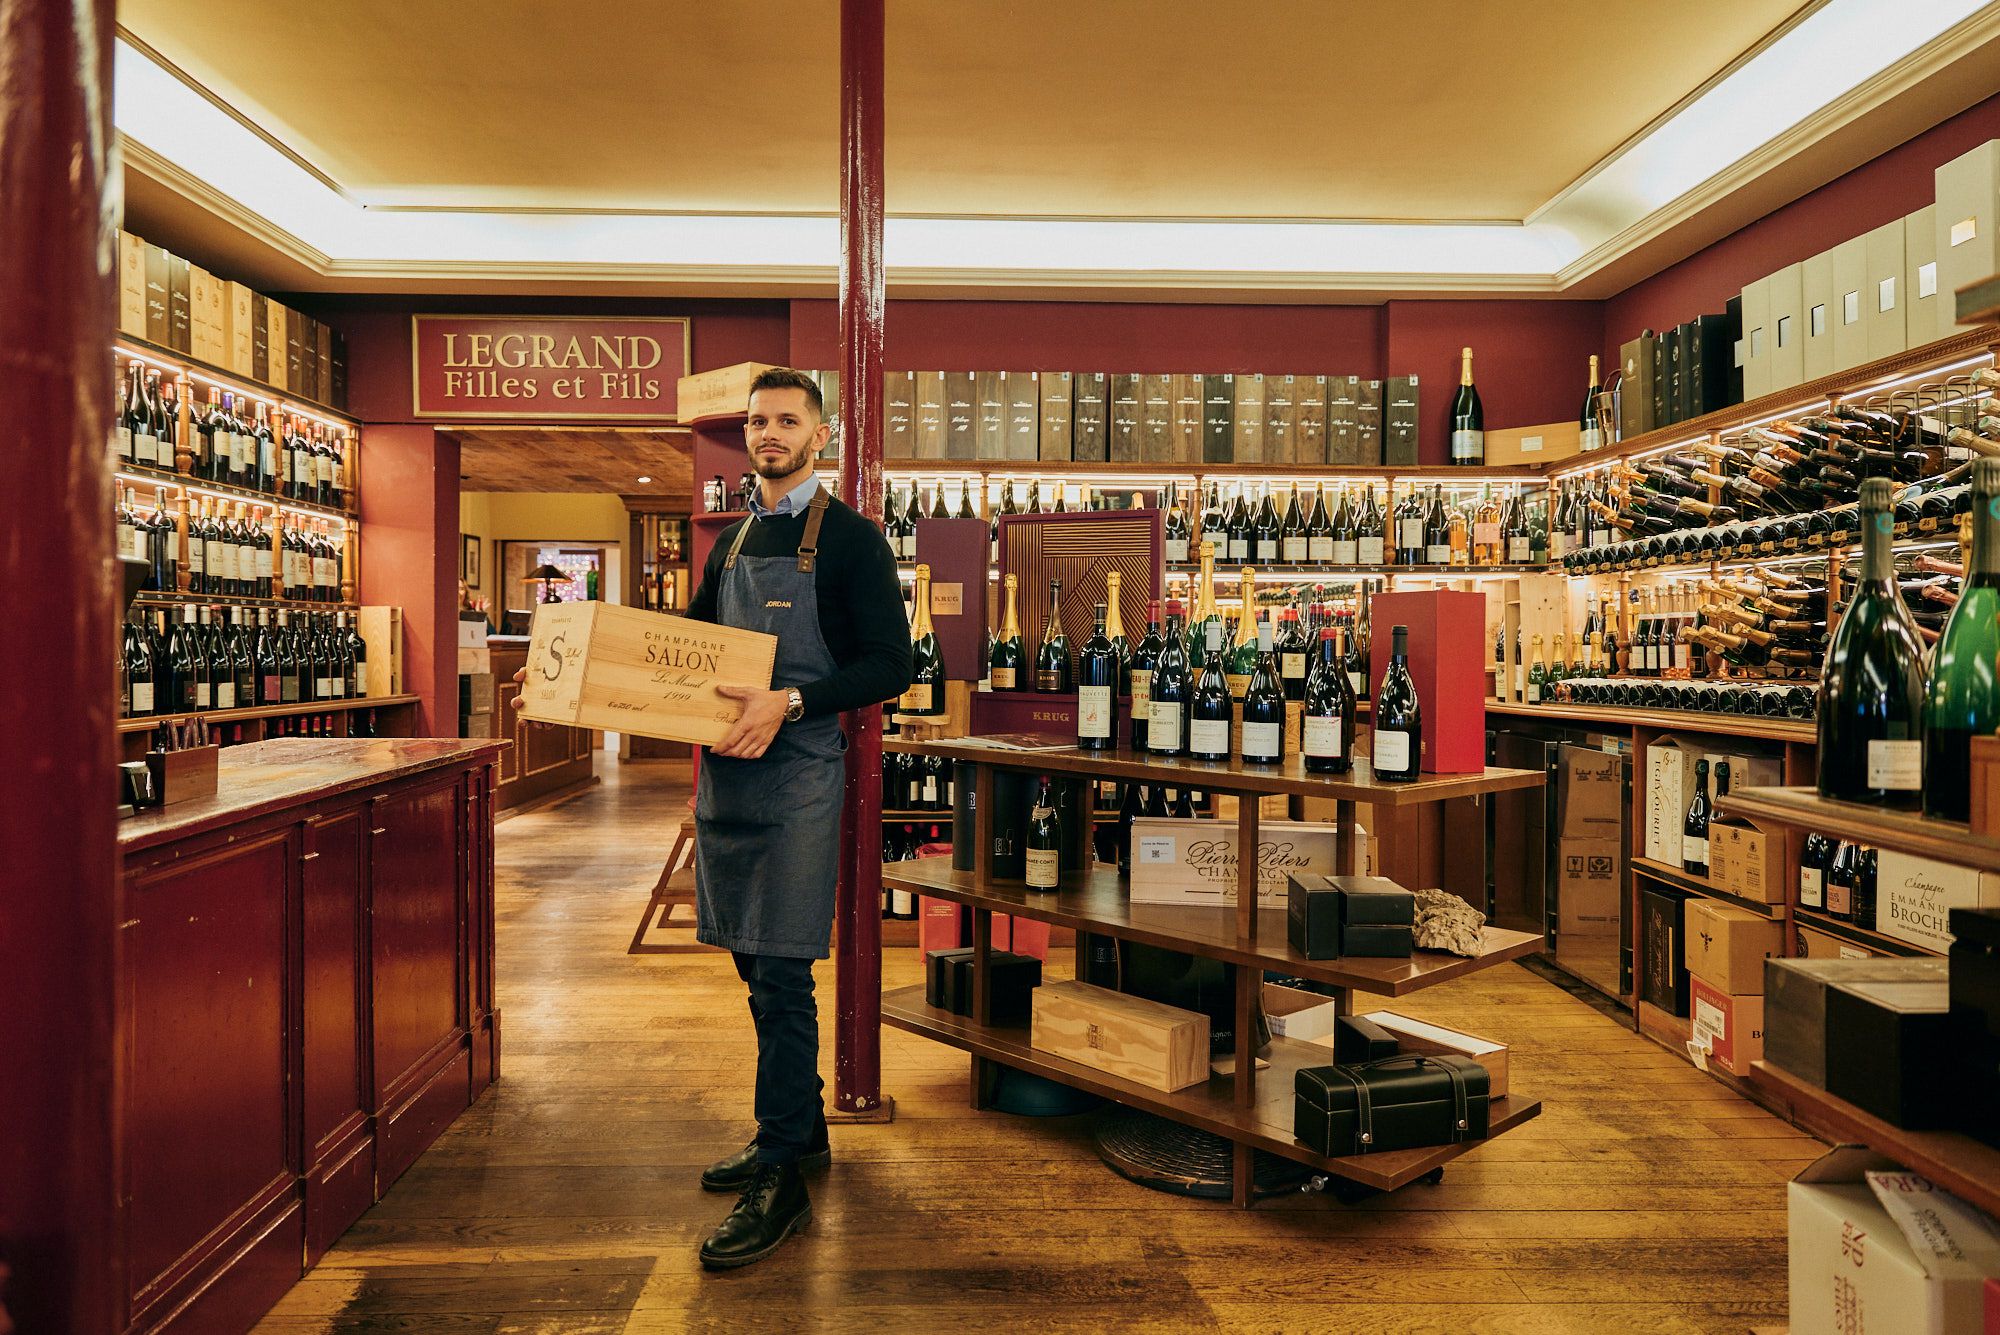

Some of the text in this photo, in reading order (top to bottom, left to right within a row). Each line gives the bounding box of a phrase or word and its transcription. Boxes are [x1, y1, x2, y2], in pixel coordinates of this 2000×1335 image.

[443, 333, 662, 370] LEGRAND
[444, 371, 538, 399] Filles
[552, 376, 586, 399] et
[600, 372, 661, 400] Fils
[765, 600, 792, 608] JORDAN
[934, 595, 960, 603] KRUG
[644, 631, 727, 652] CHAMPAGNE
[543, 630, 567, 682] S
[645, 644, 720, 674] SALON
[651, 670, 709, 689] Le Mesnil
[663, 690, 692, 701] 1999
[1032, 711, 1070, 723] KRUG
[1904, 873, 1946, 900] Champagne
[1696, 988, 1728, 1012] BOLLINGER
